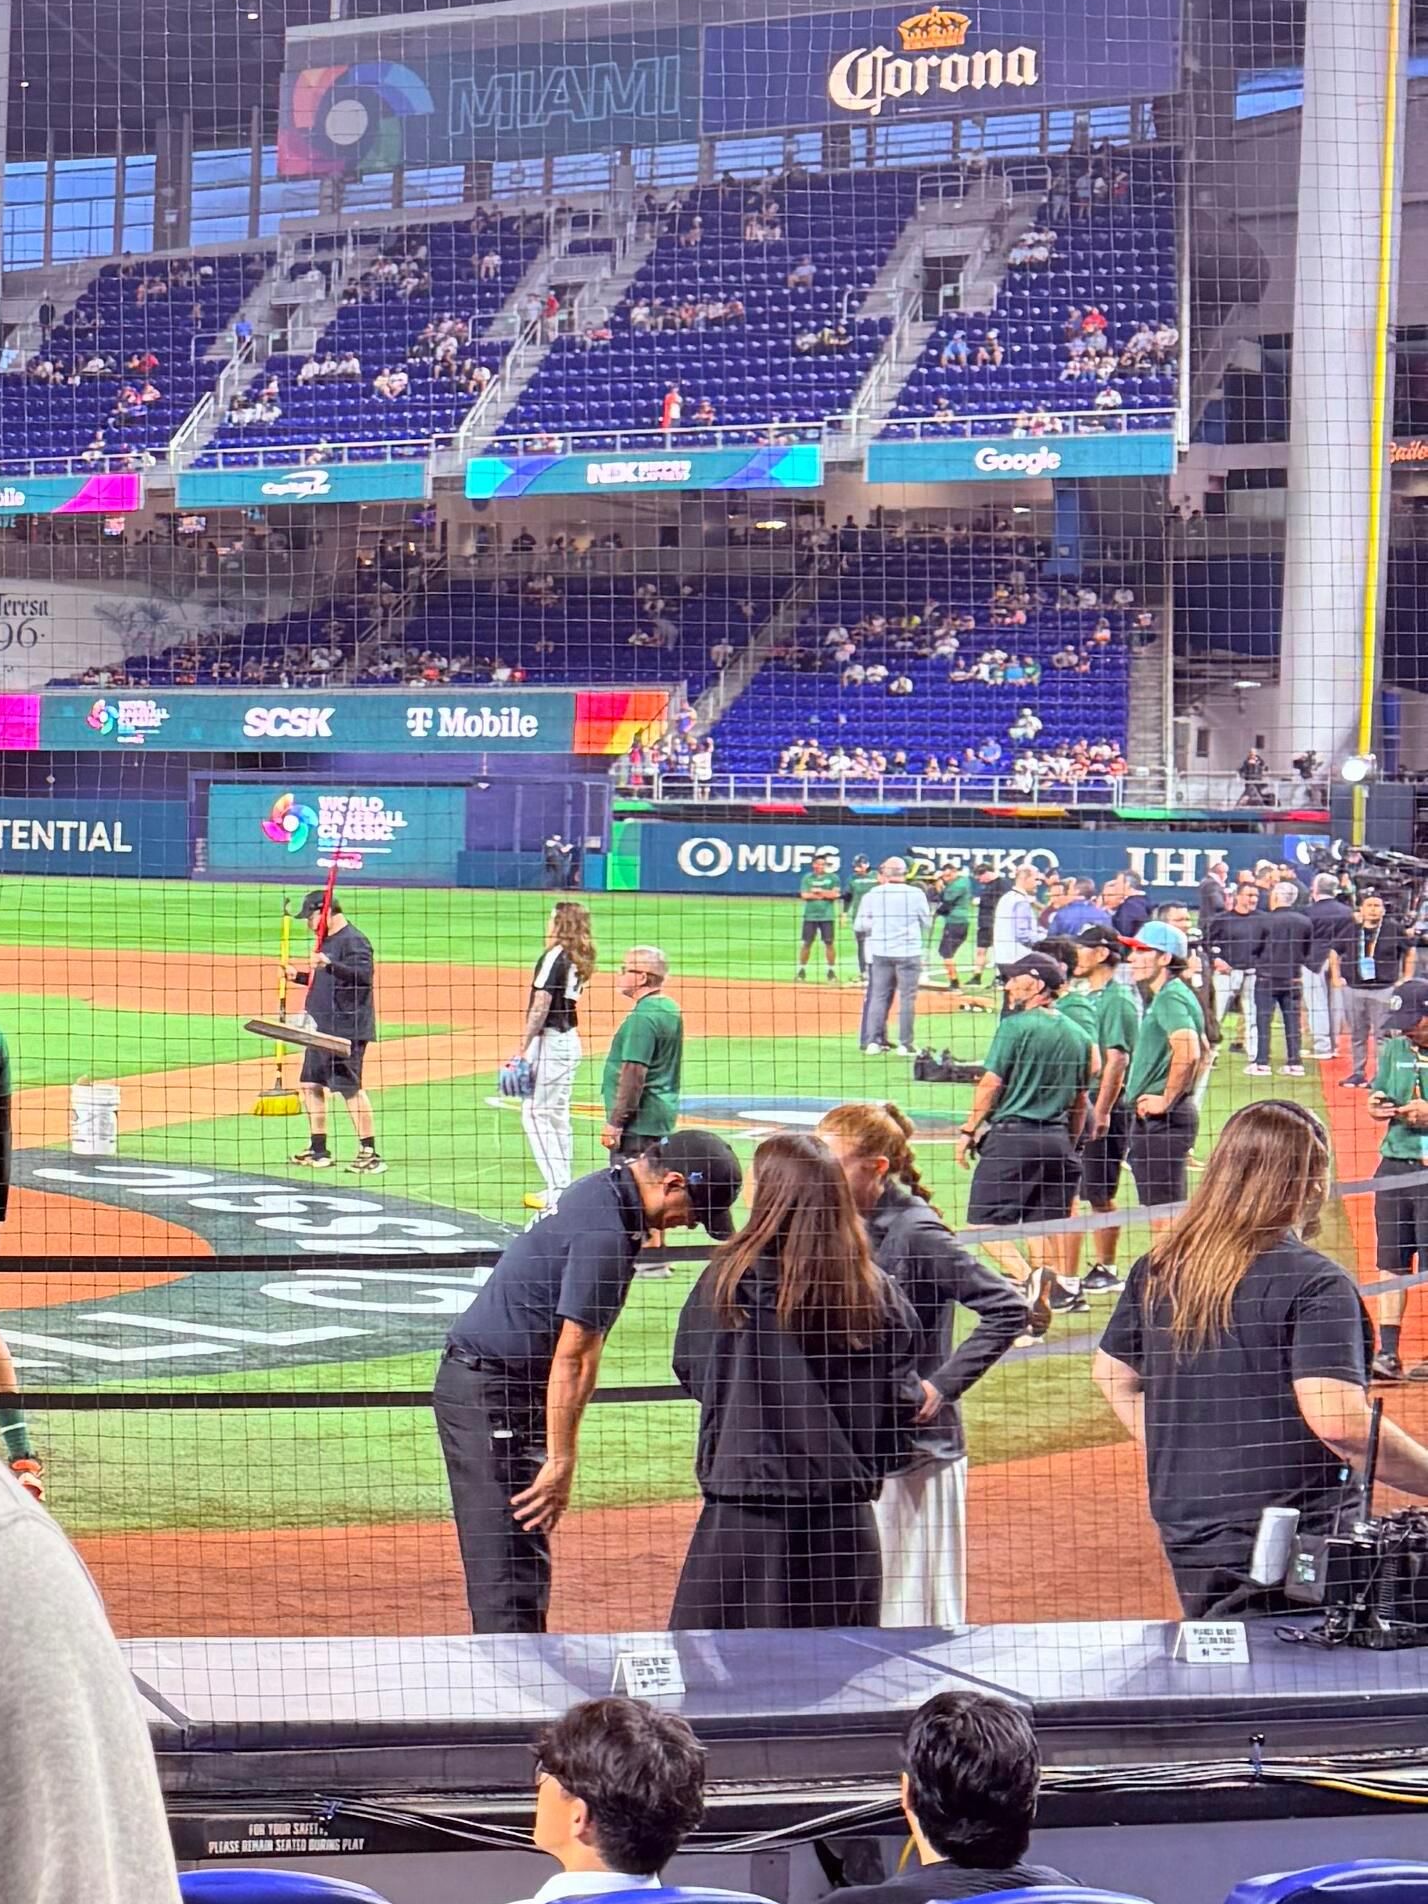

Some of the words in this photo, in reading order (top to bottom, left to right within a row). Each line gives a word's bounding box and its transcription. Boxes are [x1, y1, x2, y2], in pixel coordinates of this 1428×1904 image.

[828, 44, 1040, 116] Corona
[448, 55, 681, 136] MIAMI
[974, 446, 1062, 475] Google
[243, 707, 336, 738] SCSK
[437, 706, 539, 739] Mobile
[735, 844, 841, 873] MUFG
[248, 1823, 265, 1836] FOR
[267, 1823, 291, 1835] YOUR
[208, 1840, 240, 1854] PLEASE
[241, 1839, 274, 1853] REMAIN
[275, 1838, 307, 1852] SEATED
[307, 1838, 340, 1851] DURING
[341, 1838, 365, 1851] PLAY
